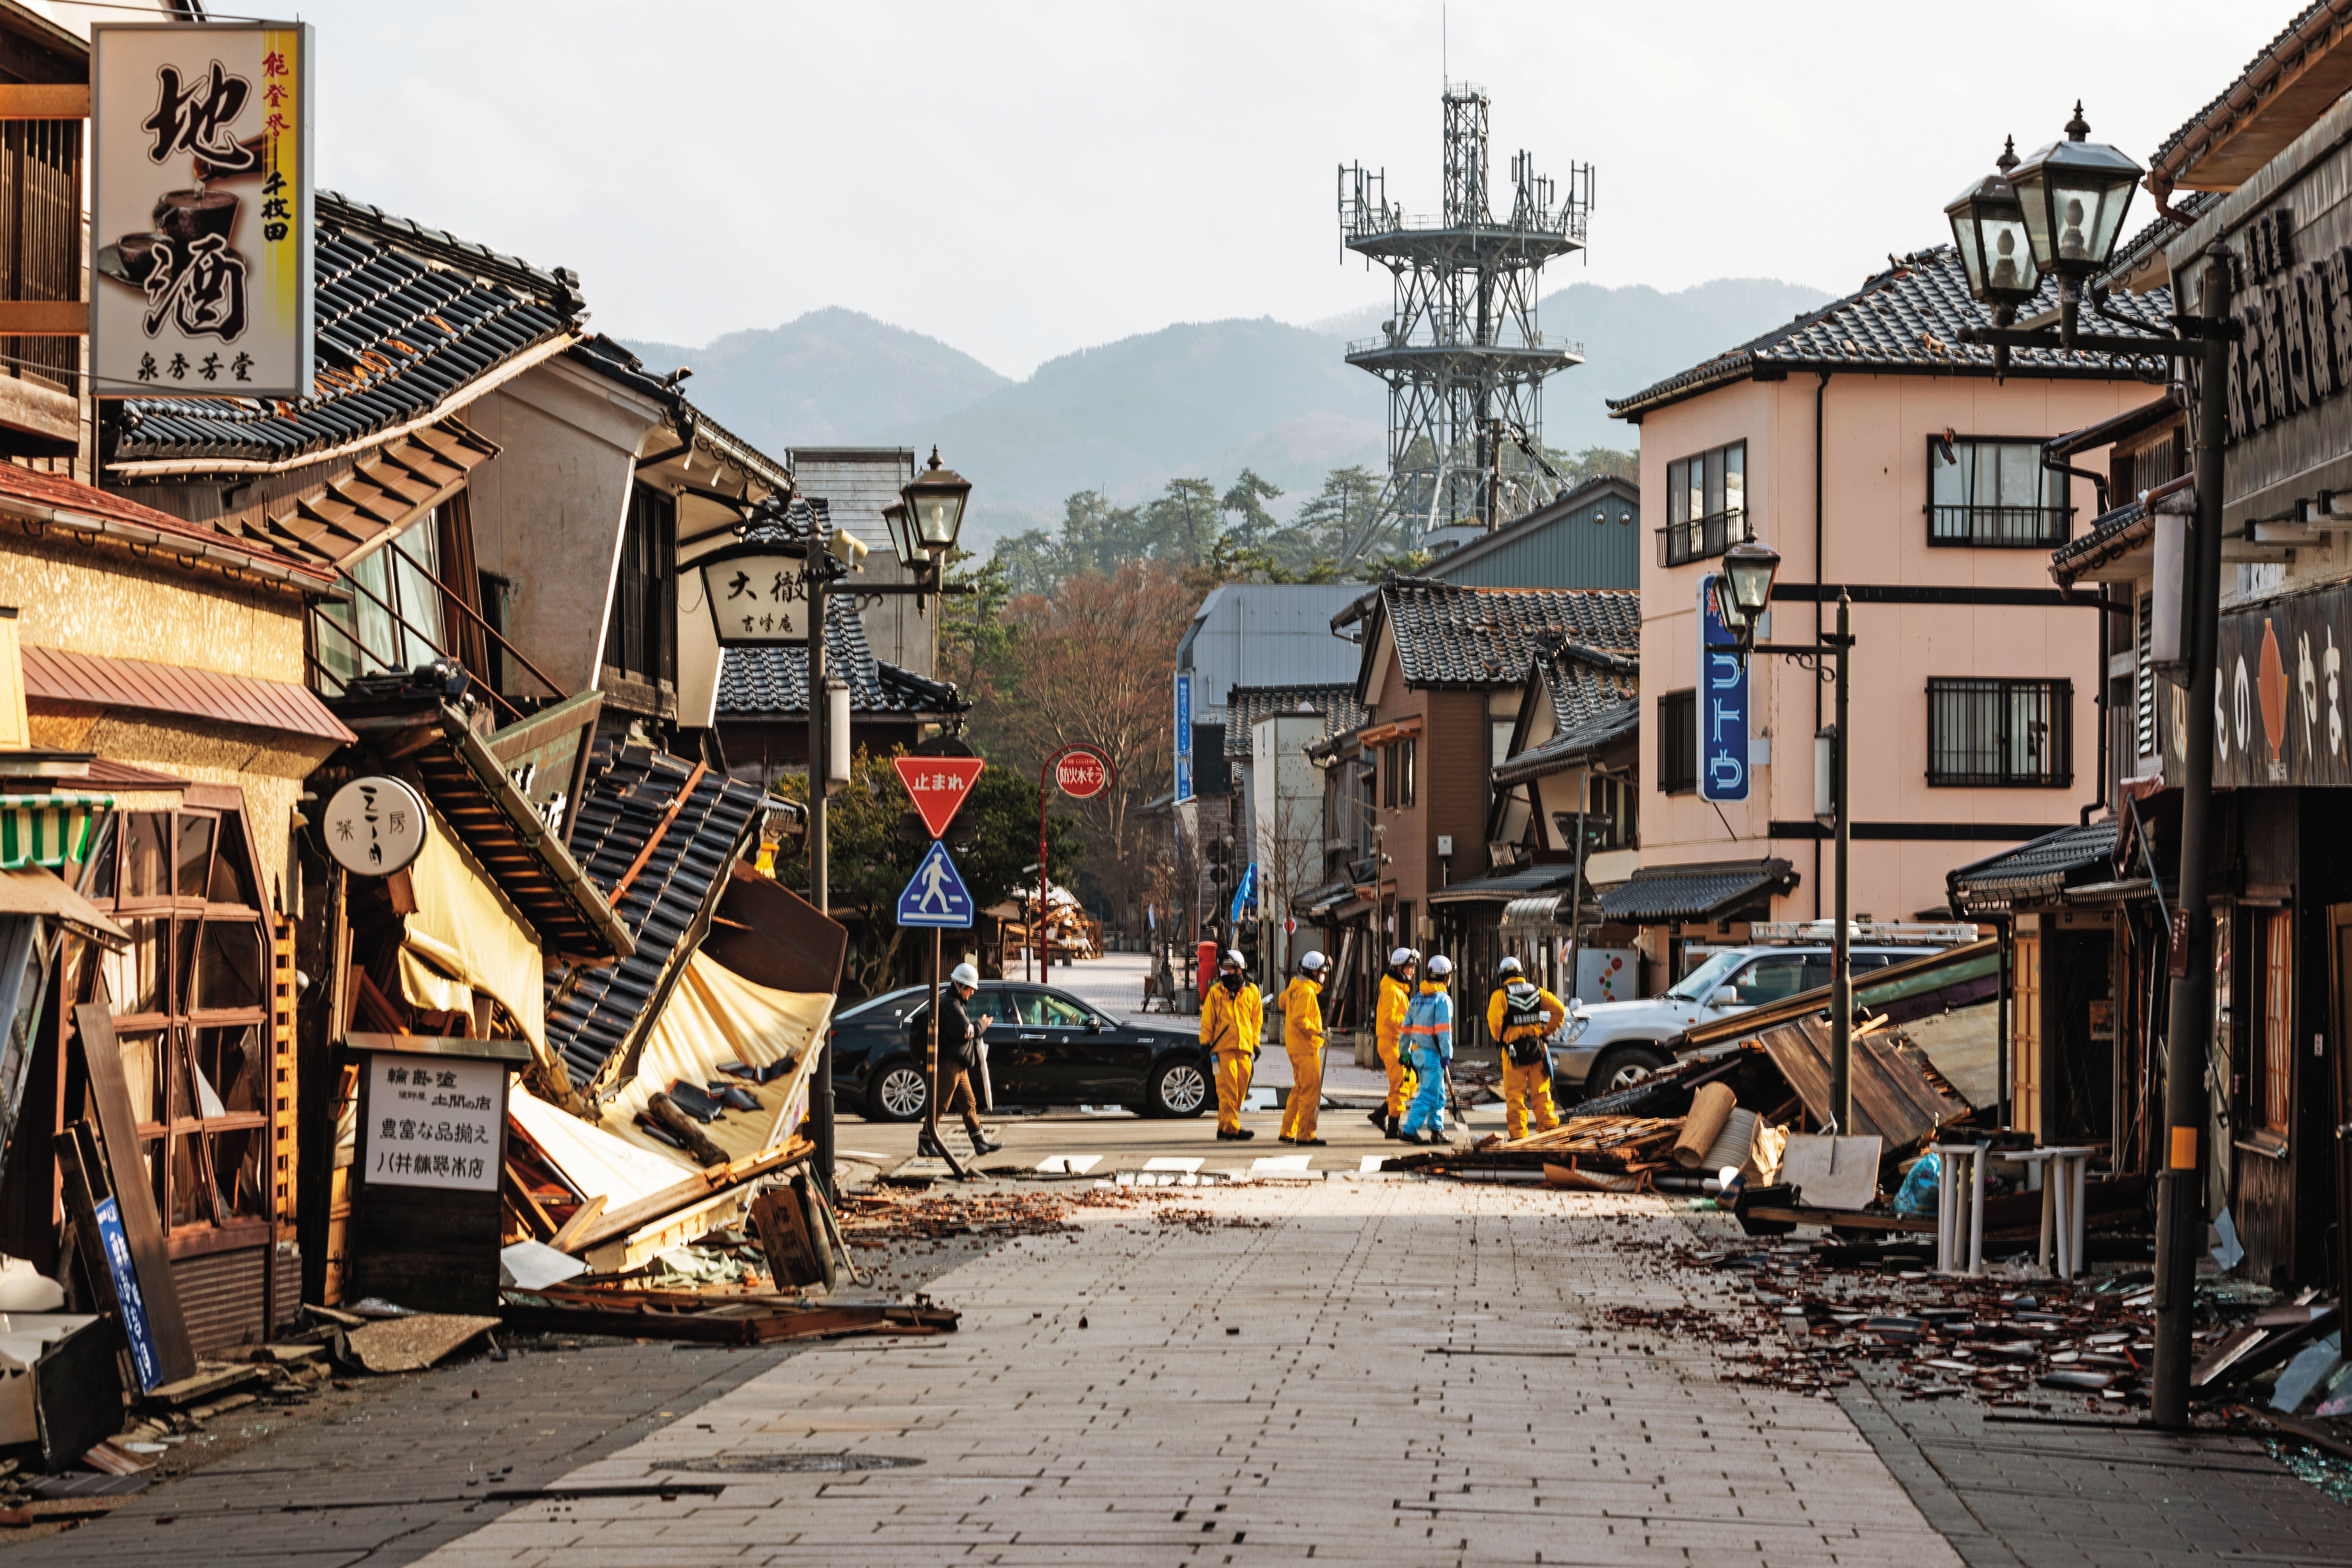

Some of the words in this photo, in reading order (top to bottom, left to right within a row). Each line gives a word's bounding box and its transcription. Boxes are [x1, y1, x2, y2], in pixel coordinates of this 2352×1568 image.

[143, 60, 254, 343] 地酒
[261, 170, 291, 242] 千枚田
[727, 570, 807, 603] 大徹
[913, 772, 964, 791] 止まれ
[1060, 766, 1103, 785] 防火水そう
[387, 1066, 457, 1089] 輪島塗
[431, 1092, 491, 1111] 土間の店
[380, 1117, 489, 1144] 豊富な品揃え
